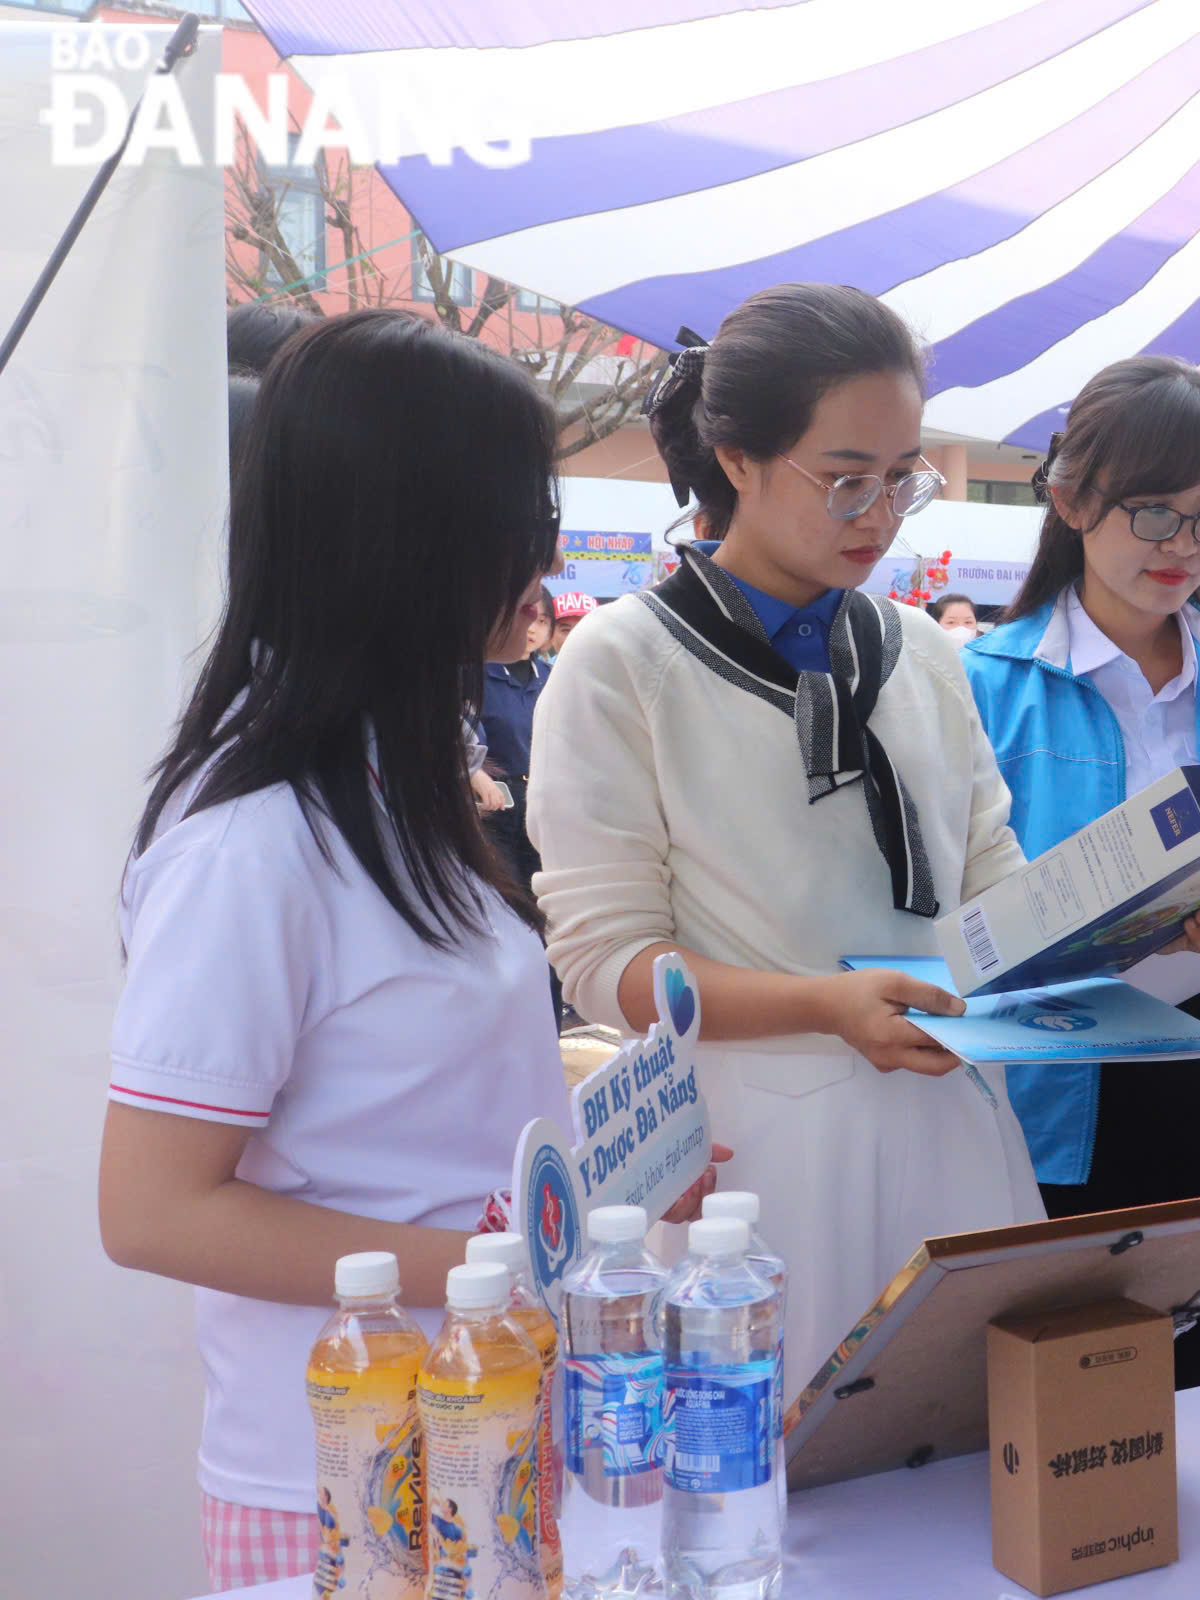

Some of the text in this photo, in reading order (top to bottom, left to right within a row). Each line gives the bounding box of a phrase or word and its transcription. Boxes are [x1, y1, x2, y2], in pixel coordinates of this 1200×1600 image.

[1165, 807, 1181, 837] NEFER
[583, 1033, 676, 1138] ĐH Kỹ thuật
[578, 1126, 635, 1198] Y-Dược
[634, 1098, 658, 1144] Đà
[1108, 1525, 1155, 1552] inphic
